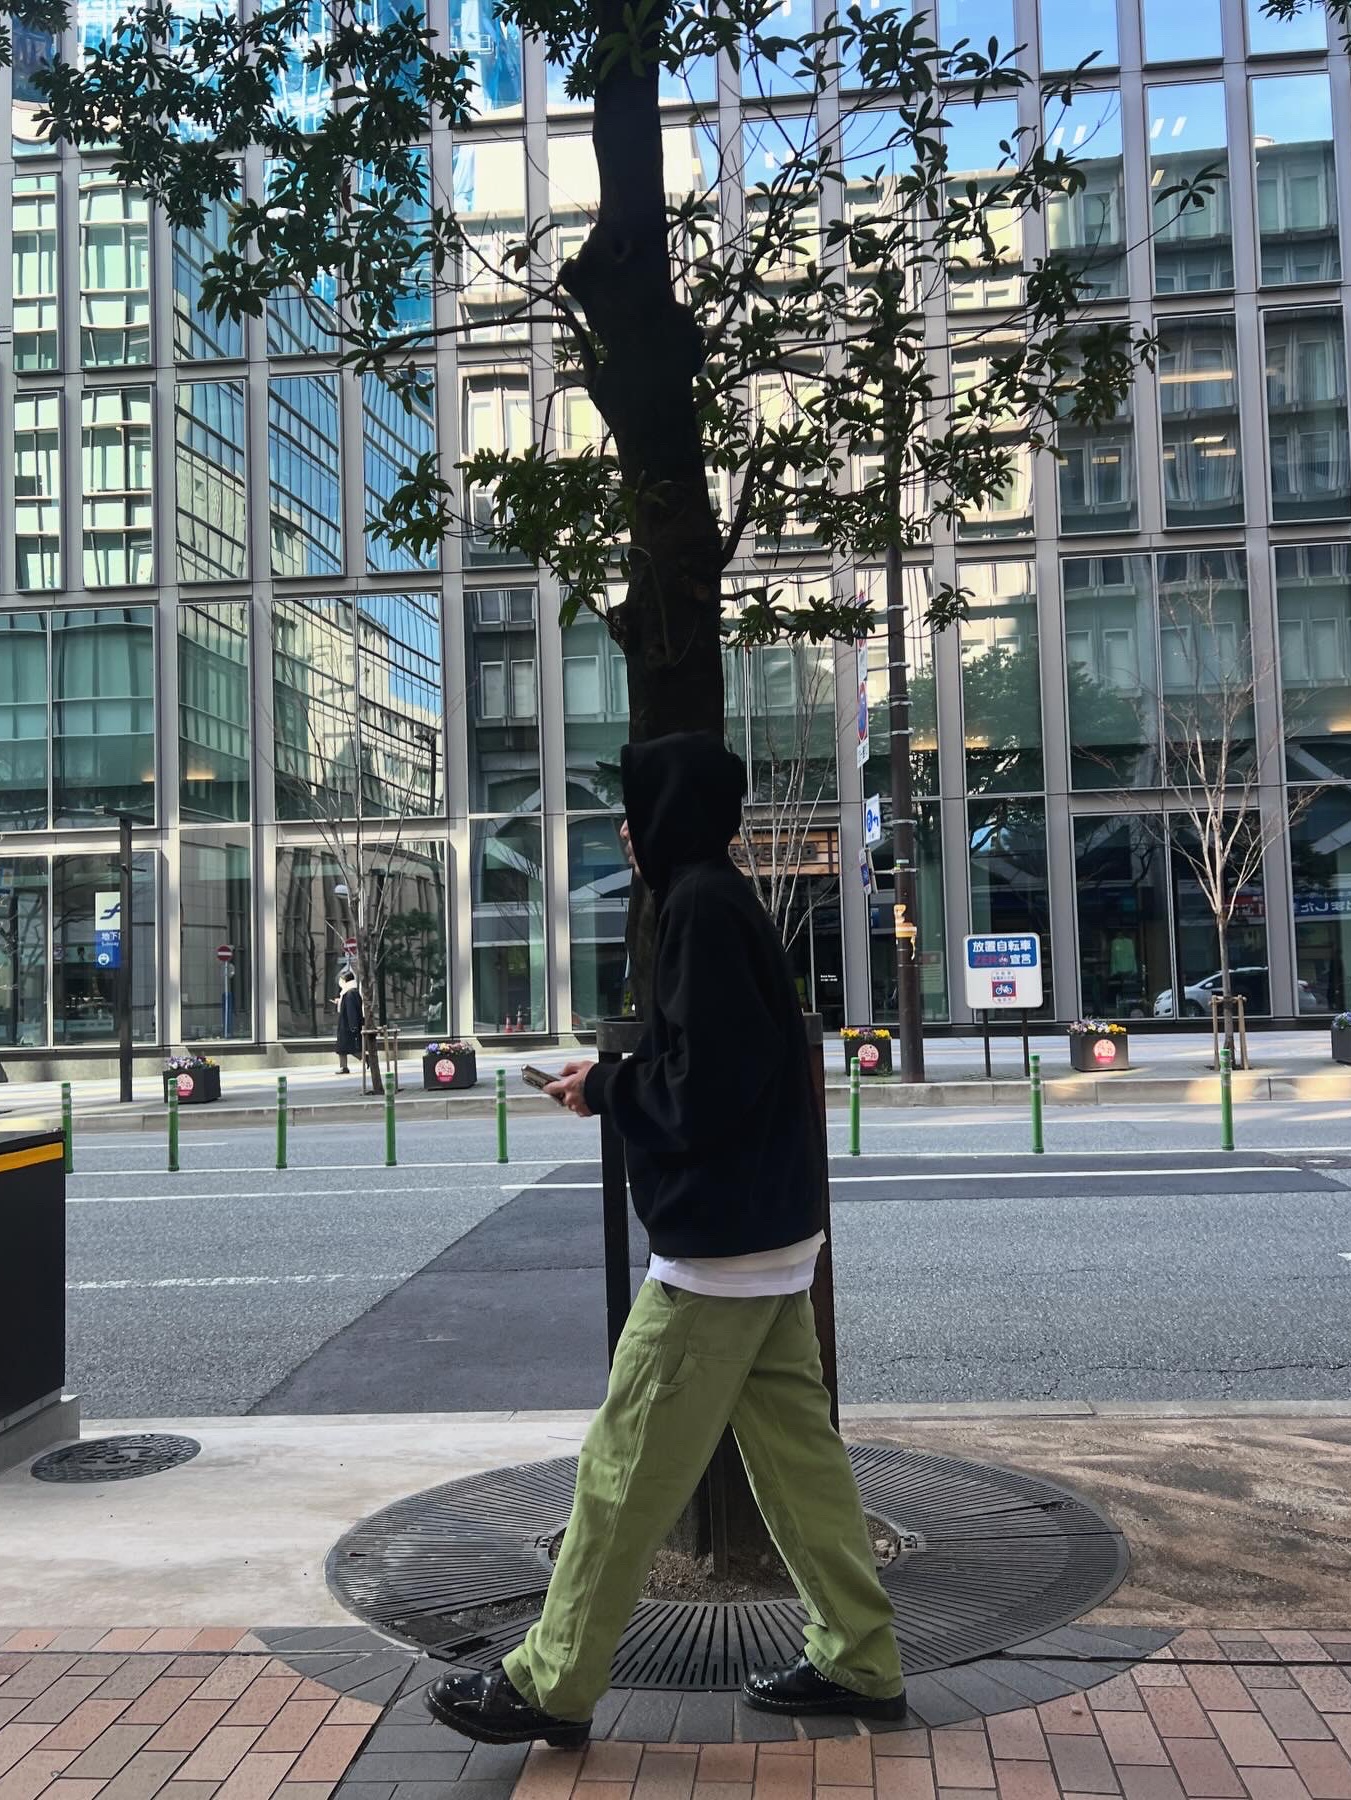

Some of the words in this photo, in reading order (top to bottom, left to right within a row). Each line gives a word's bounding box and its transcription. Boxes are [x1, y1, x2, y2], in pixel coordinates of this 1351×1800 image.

[101, 932, 120, 941] 地下
[972, 939, 1032, 953] 放置自転車
